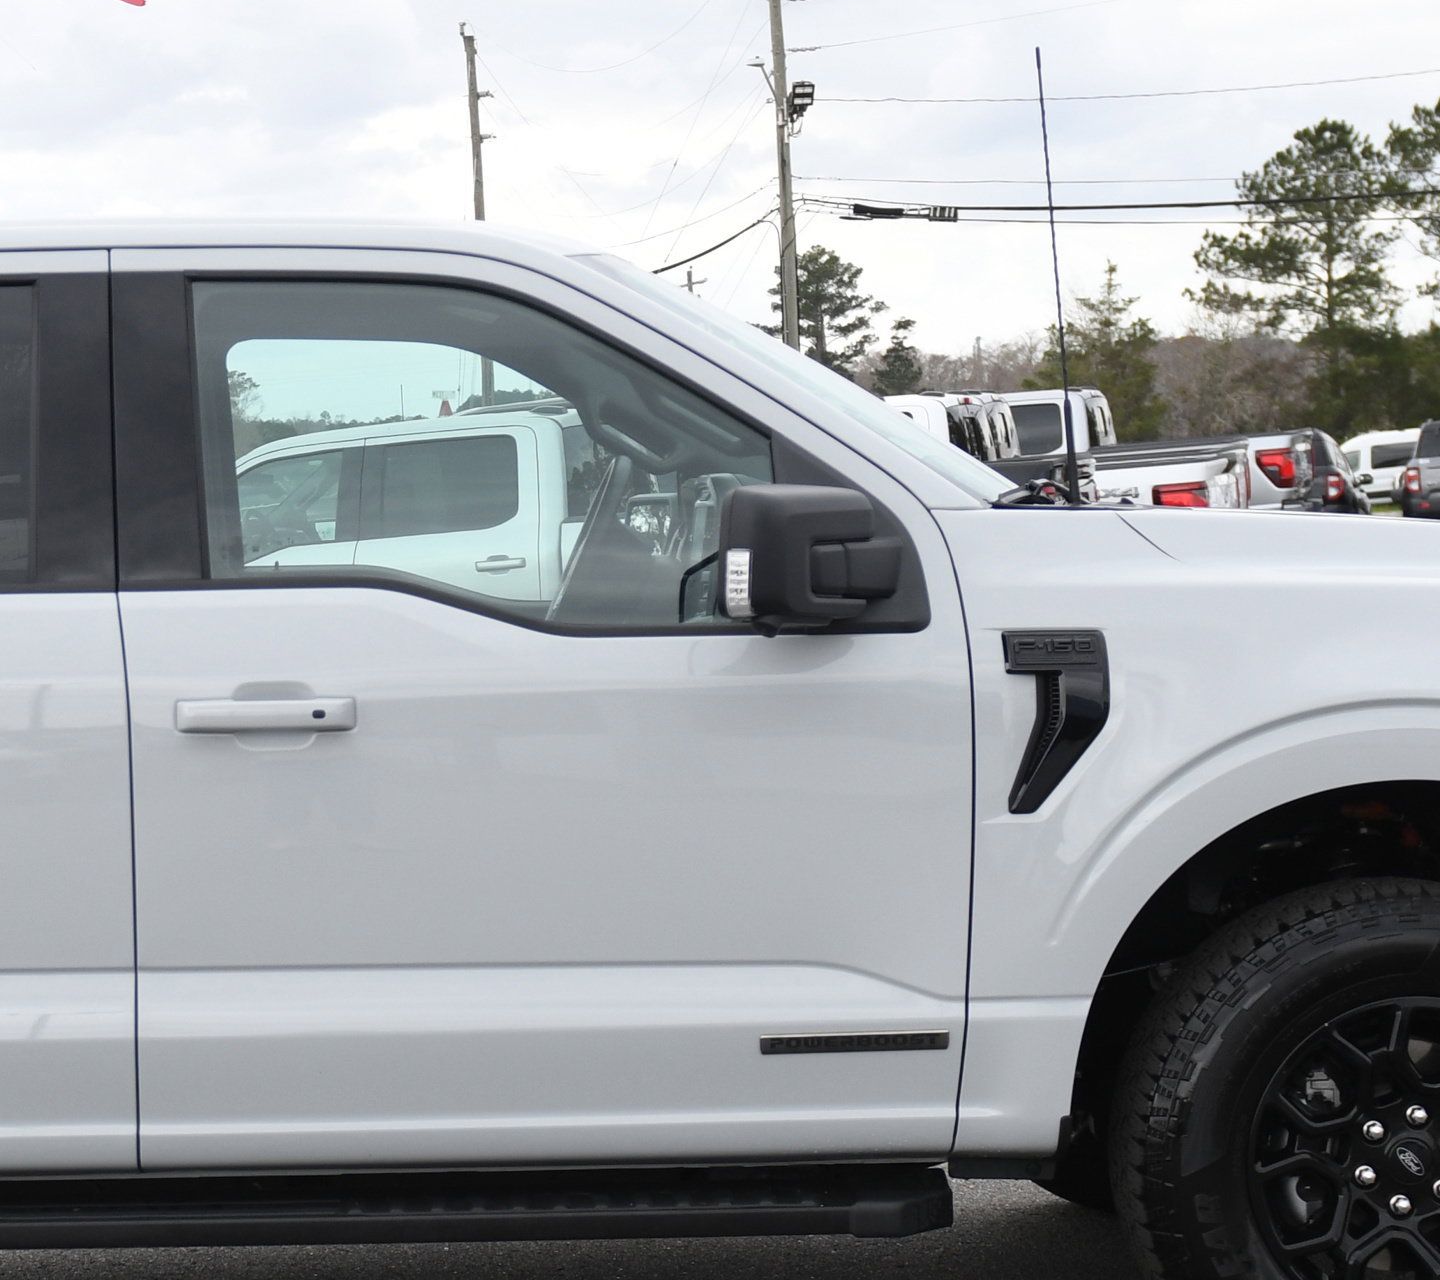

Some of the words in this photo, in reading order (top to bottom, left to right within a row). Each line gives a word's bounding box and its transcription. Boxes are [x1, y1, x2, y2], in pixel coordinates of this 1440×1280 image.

[1013, 638, 1096, 653] F-150
[770, 1033, 942, 1050] POWERBOOST
[1400, 1152, 1421, 1171] Ford
